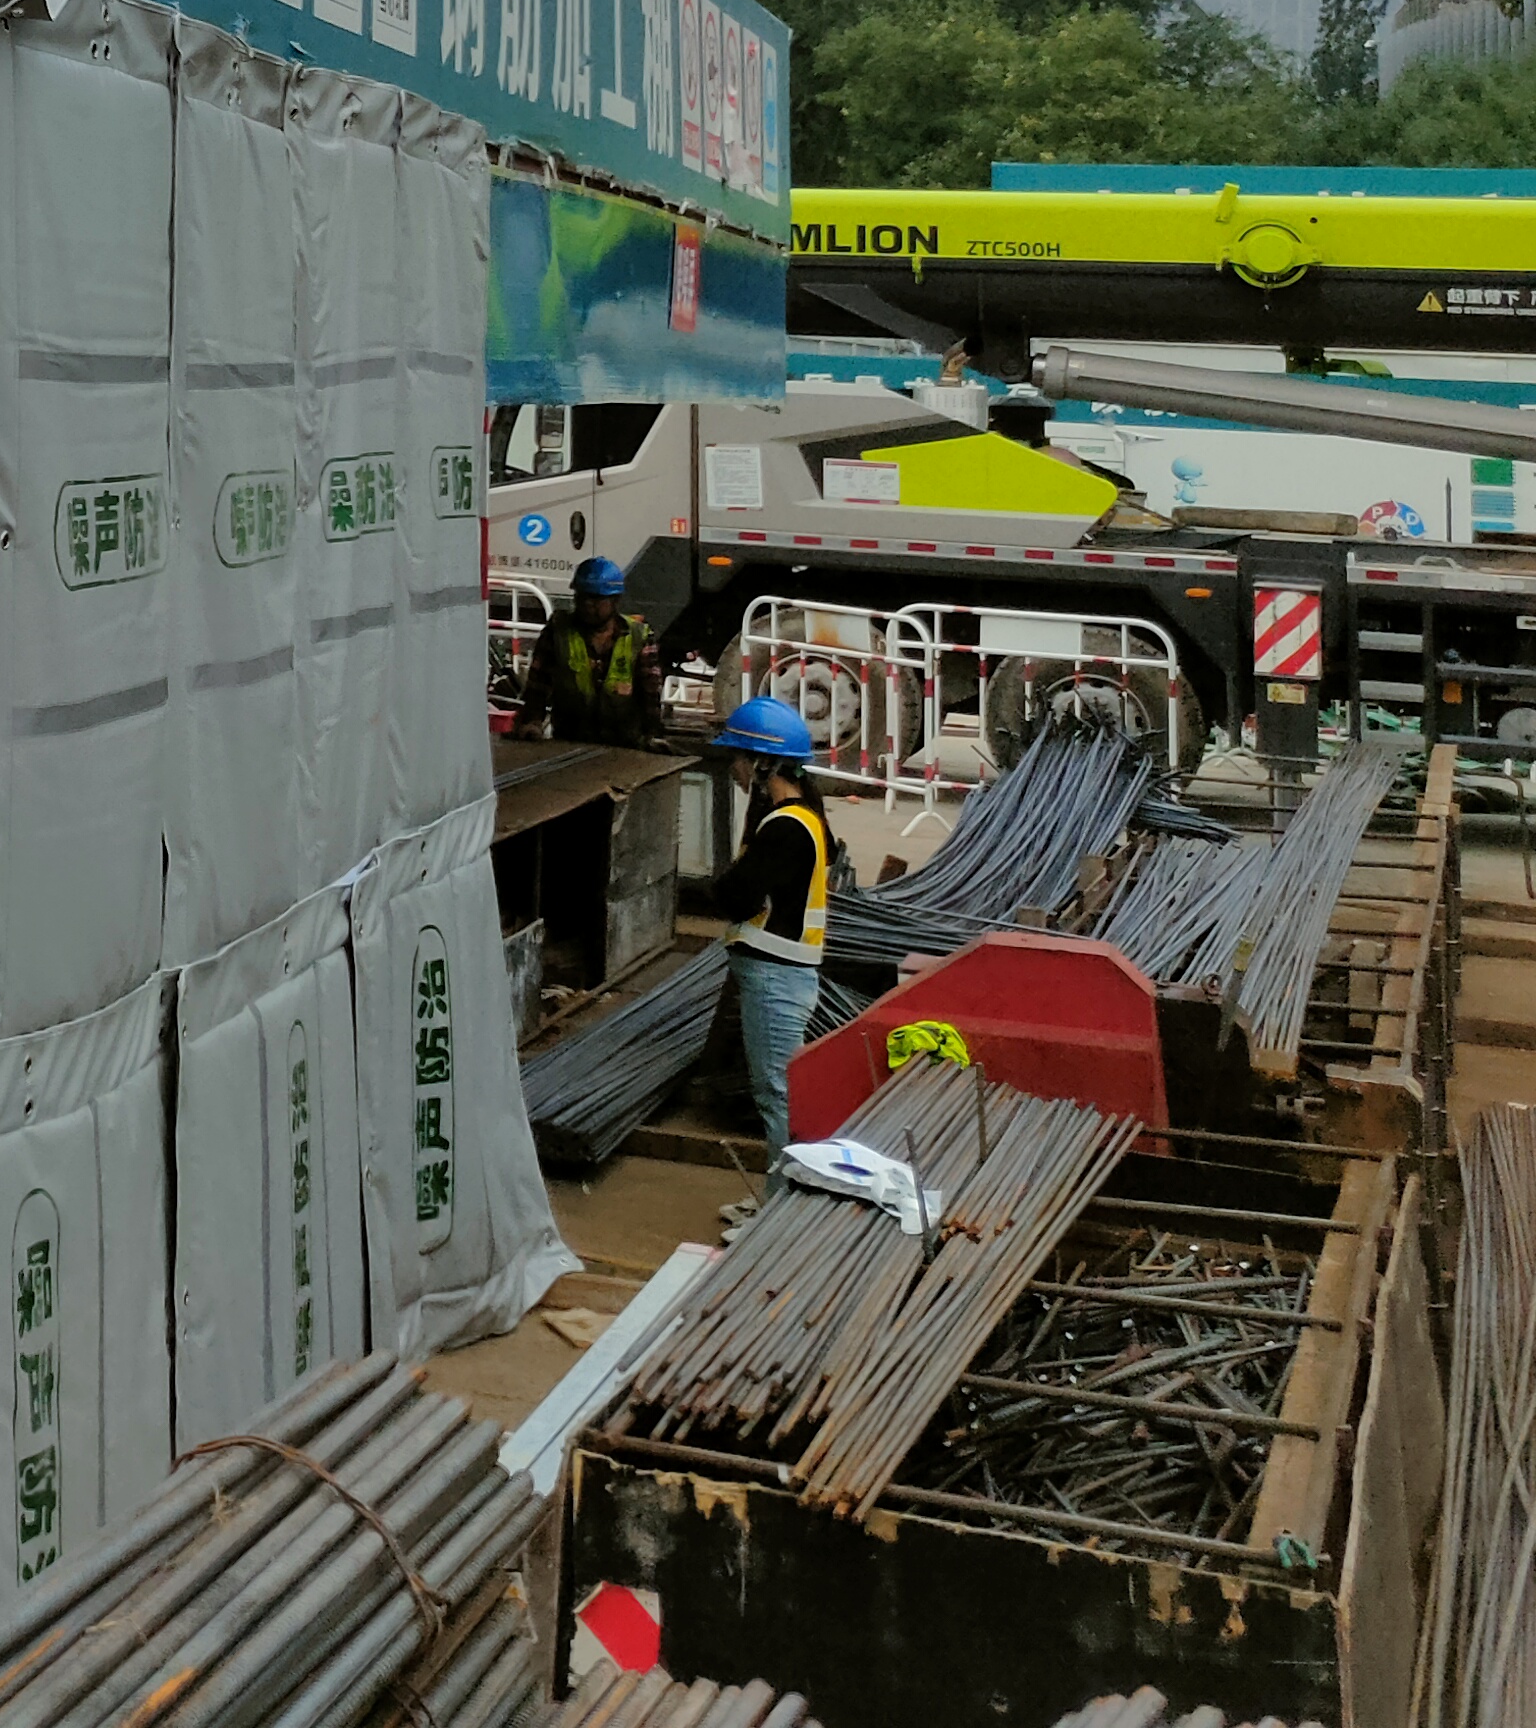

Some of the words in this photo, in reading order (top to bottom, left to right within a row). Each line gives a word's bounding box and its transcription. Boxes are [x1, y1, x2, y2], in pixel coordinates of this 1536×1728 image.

[966, 240, 1061, 258] ZTC500H
[1371, 506, 1384, 520] P
[1406, 512, 1420, 526] D
[525, 518, 544, 542] 2
[416, 958, 450, 1222] 噪声防治
